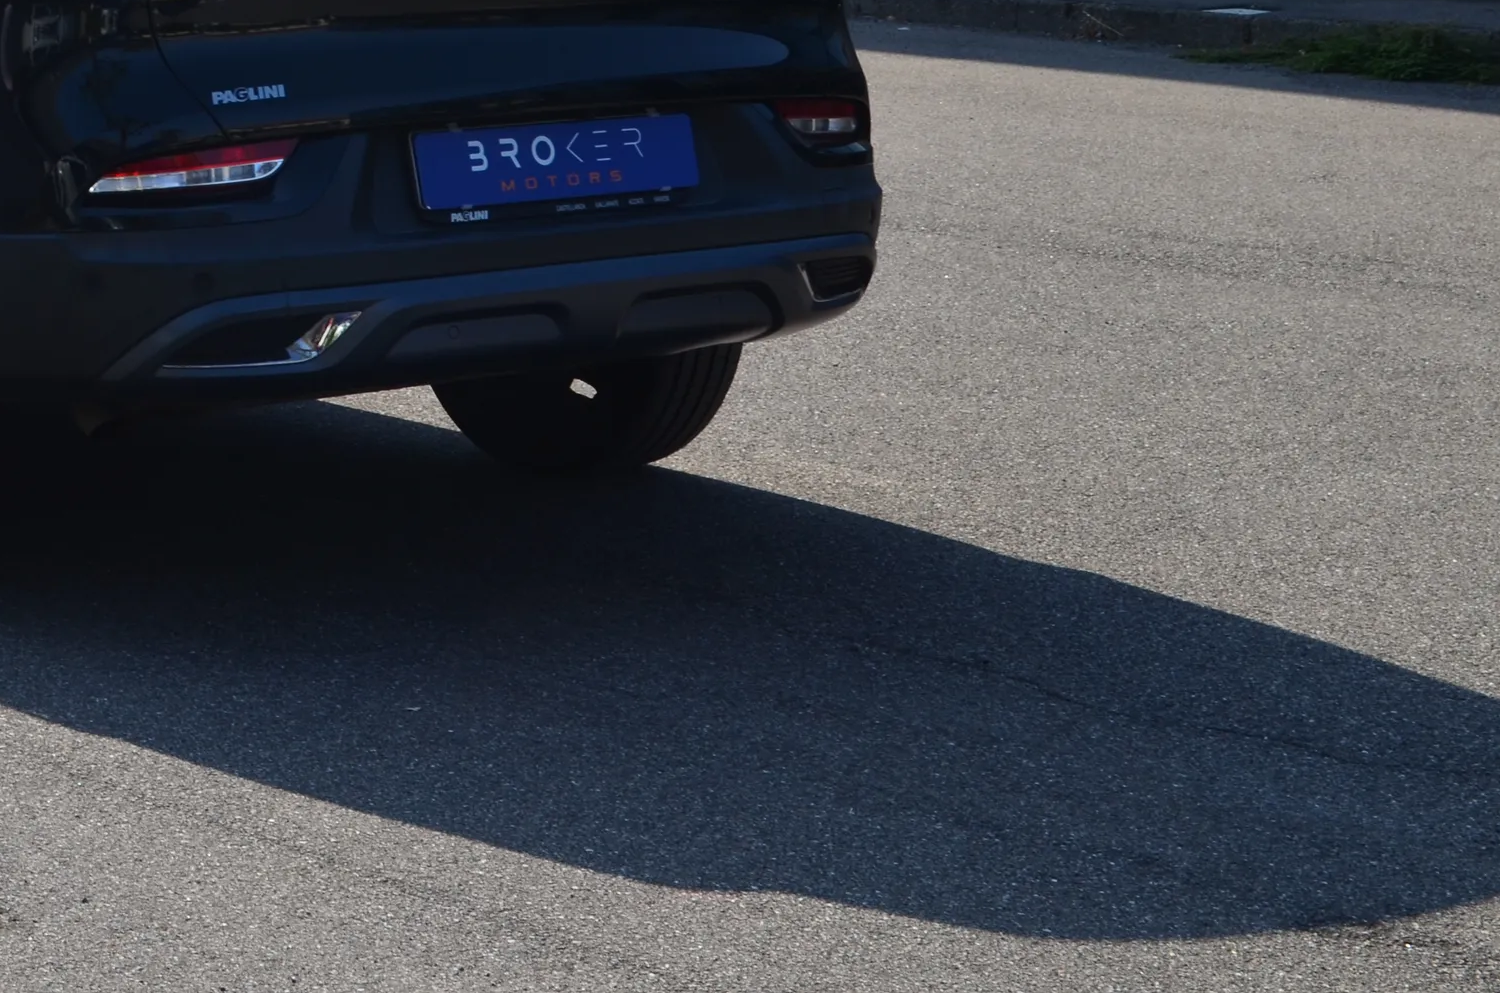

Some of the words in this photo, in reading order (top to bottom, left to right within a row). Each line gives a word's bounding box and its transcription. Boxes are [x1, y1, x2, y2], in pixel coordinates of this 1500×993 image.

[211, 84, 286, 106] PAGLINI
[467, 127, 644, 173] BROKER
[501, 170, 623, 192] MOTORS
[450, 210, 489, 223] PAGLINI
